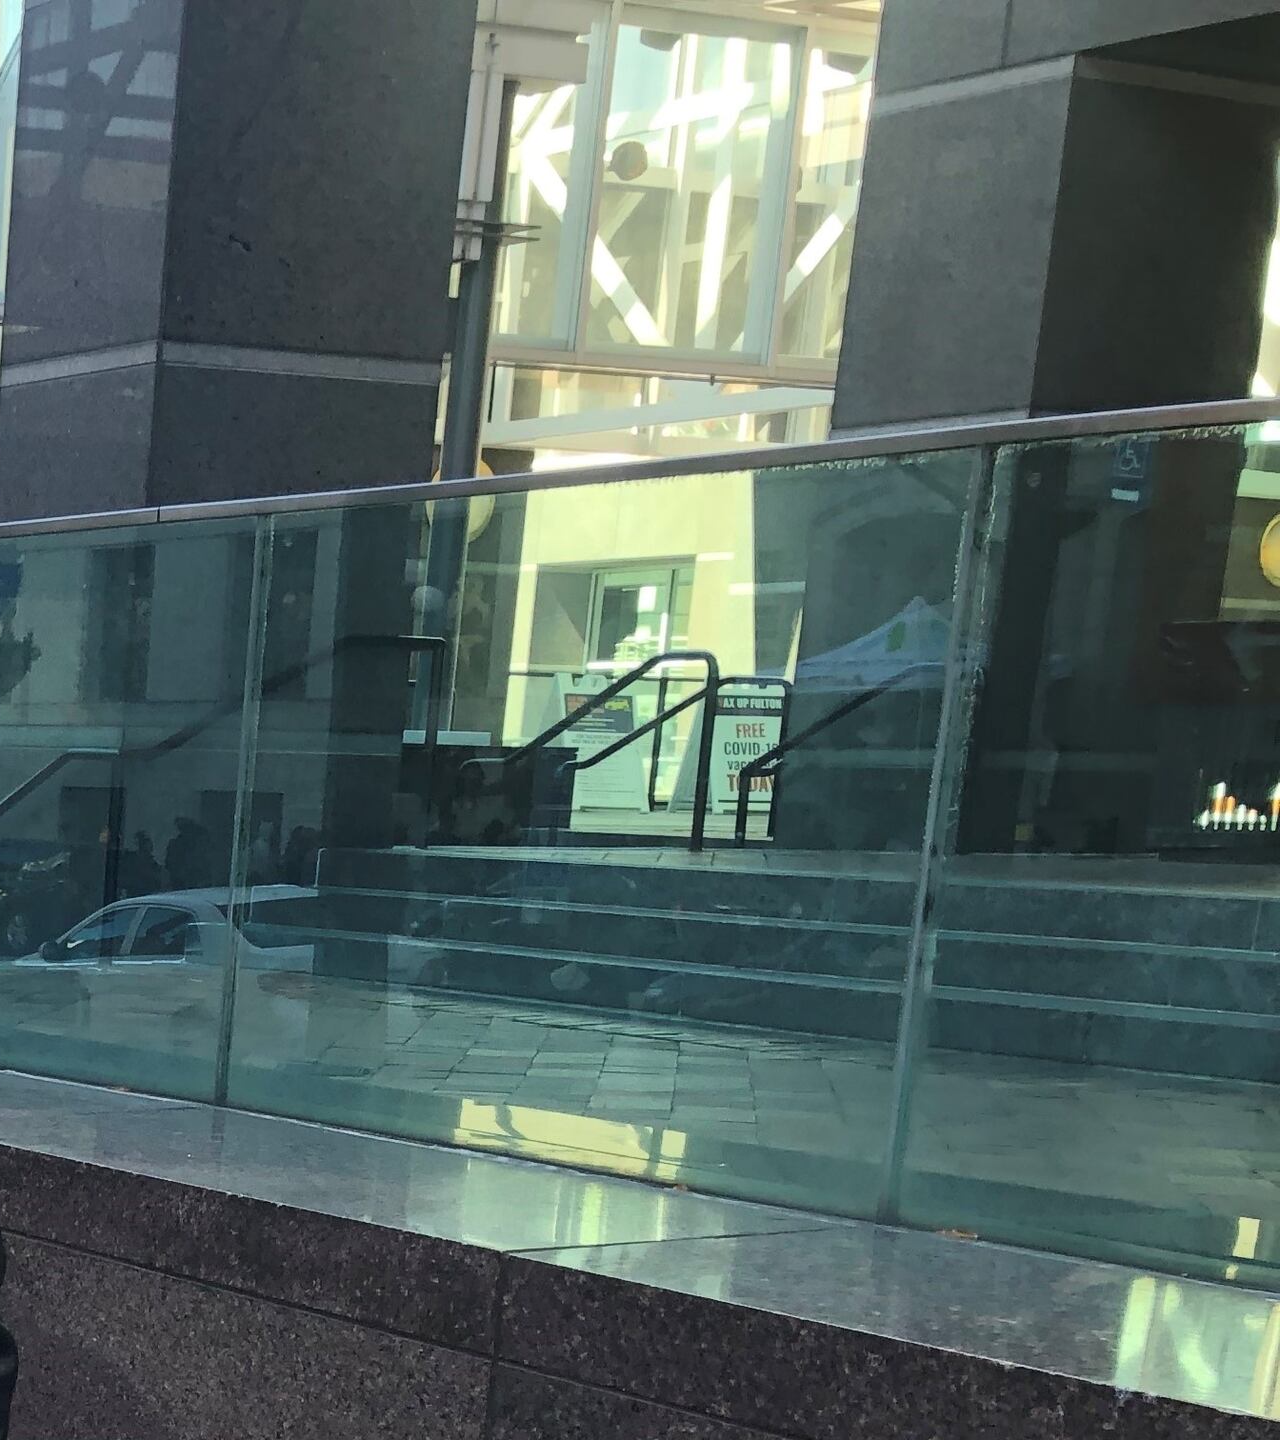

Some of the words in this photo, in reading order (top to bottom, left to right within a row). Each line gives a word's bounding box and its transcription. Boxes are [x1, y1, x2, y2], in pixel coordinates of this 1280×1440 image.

[736, 698, 749, 709] UP
[750, 698, 782, 710] FULTON
[736, 723, 765, 739] FREE
